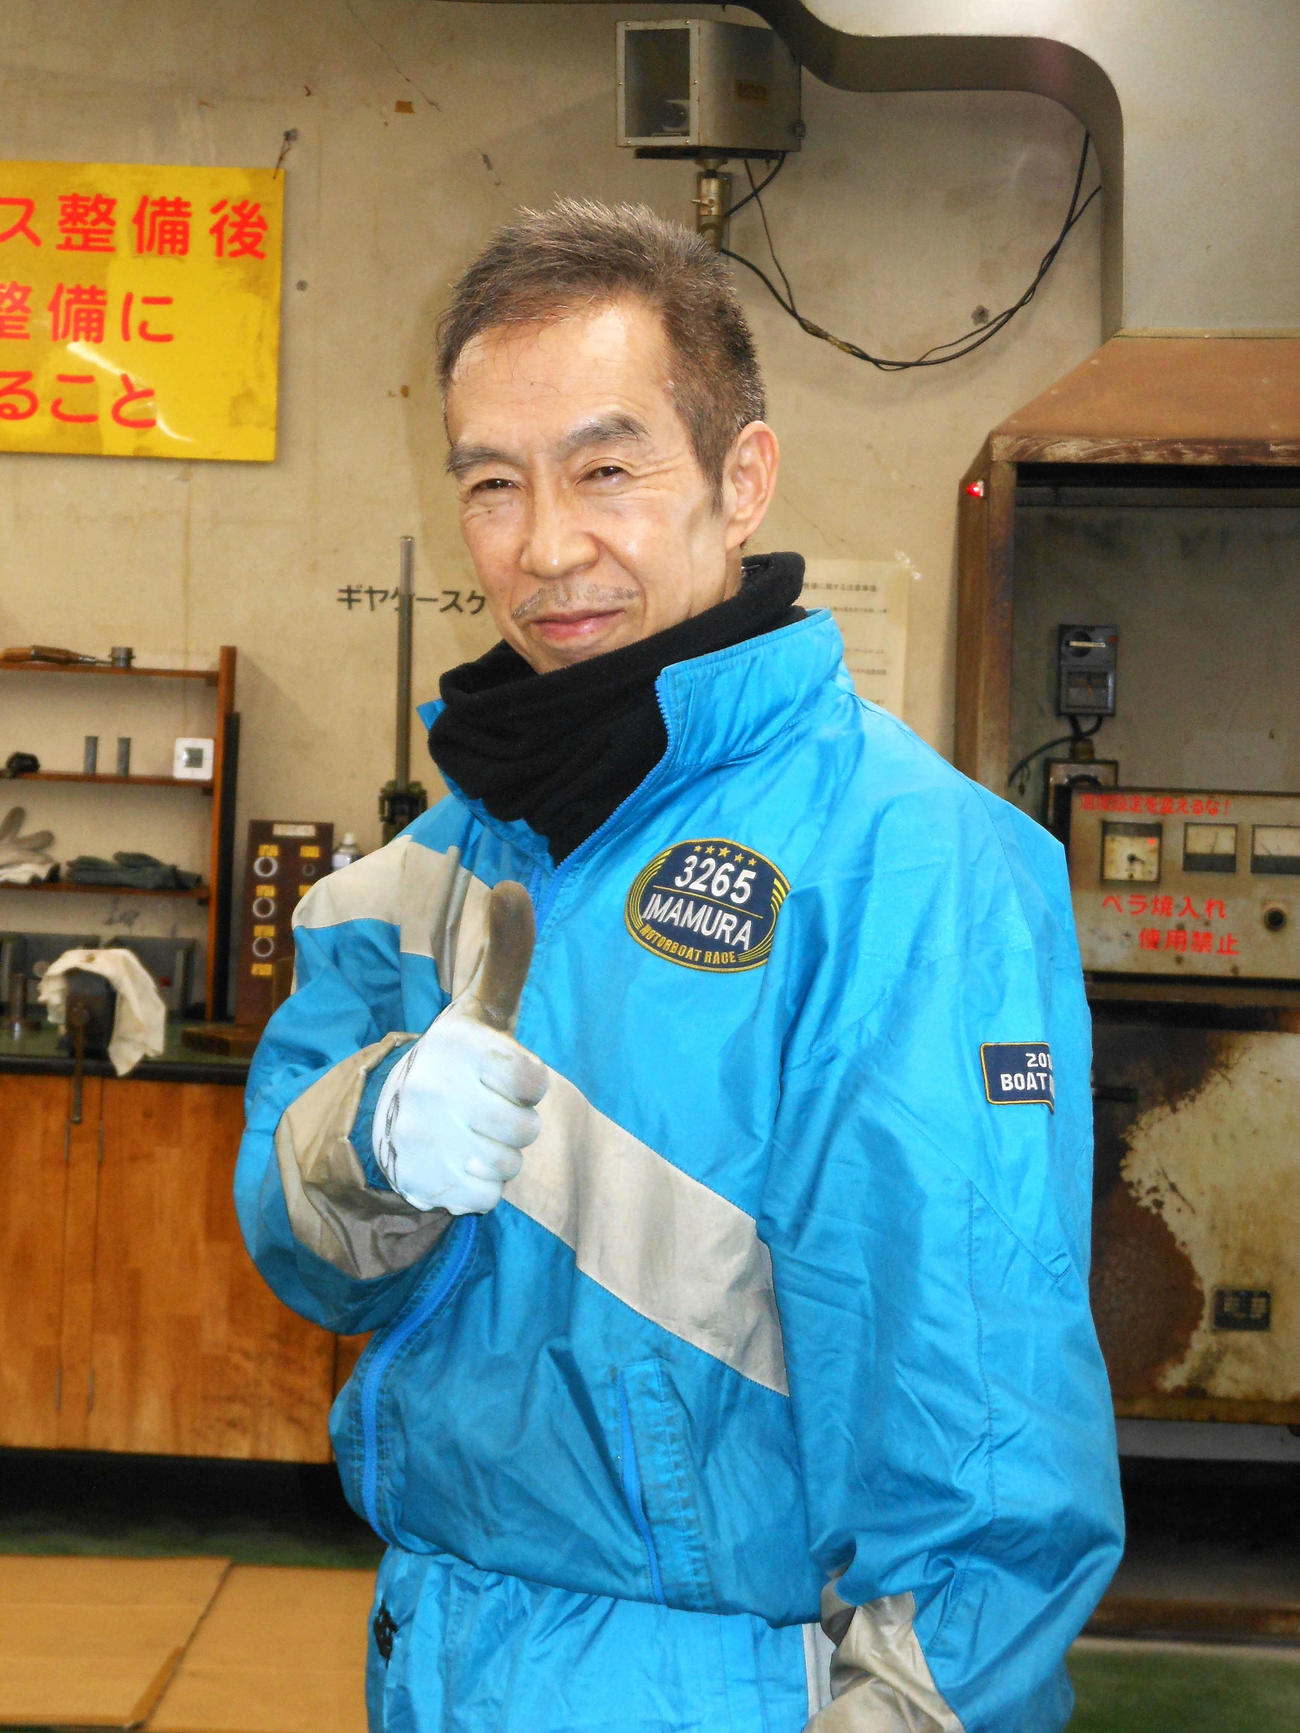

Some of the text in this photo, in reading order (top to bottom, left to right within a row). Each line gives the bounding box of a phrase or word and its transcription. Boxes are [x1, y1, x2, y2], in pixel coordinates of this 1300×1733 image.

[0, 193, 267, 259] ス整備後
[0, 371, 156, 428] ること
[674, 855, 756, 904] 3265
[639, 924, 736, 964] MOTORBOAT RACE
[641, 893, 752, 950] IMAMURA
[1139, 928, 1239, 955] 使用禁止
[1000, 1072, 1047, 1091] BOAT
